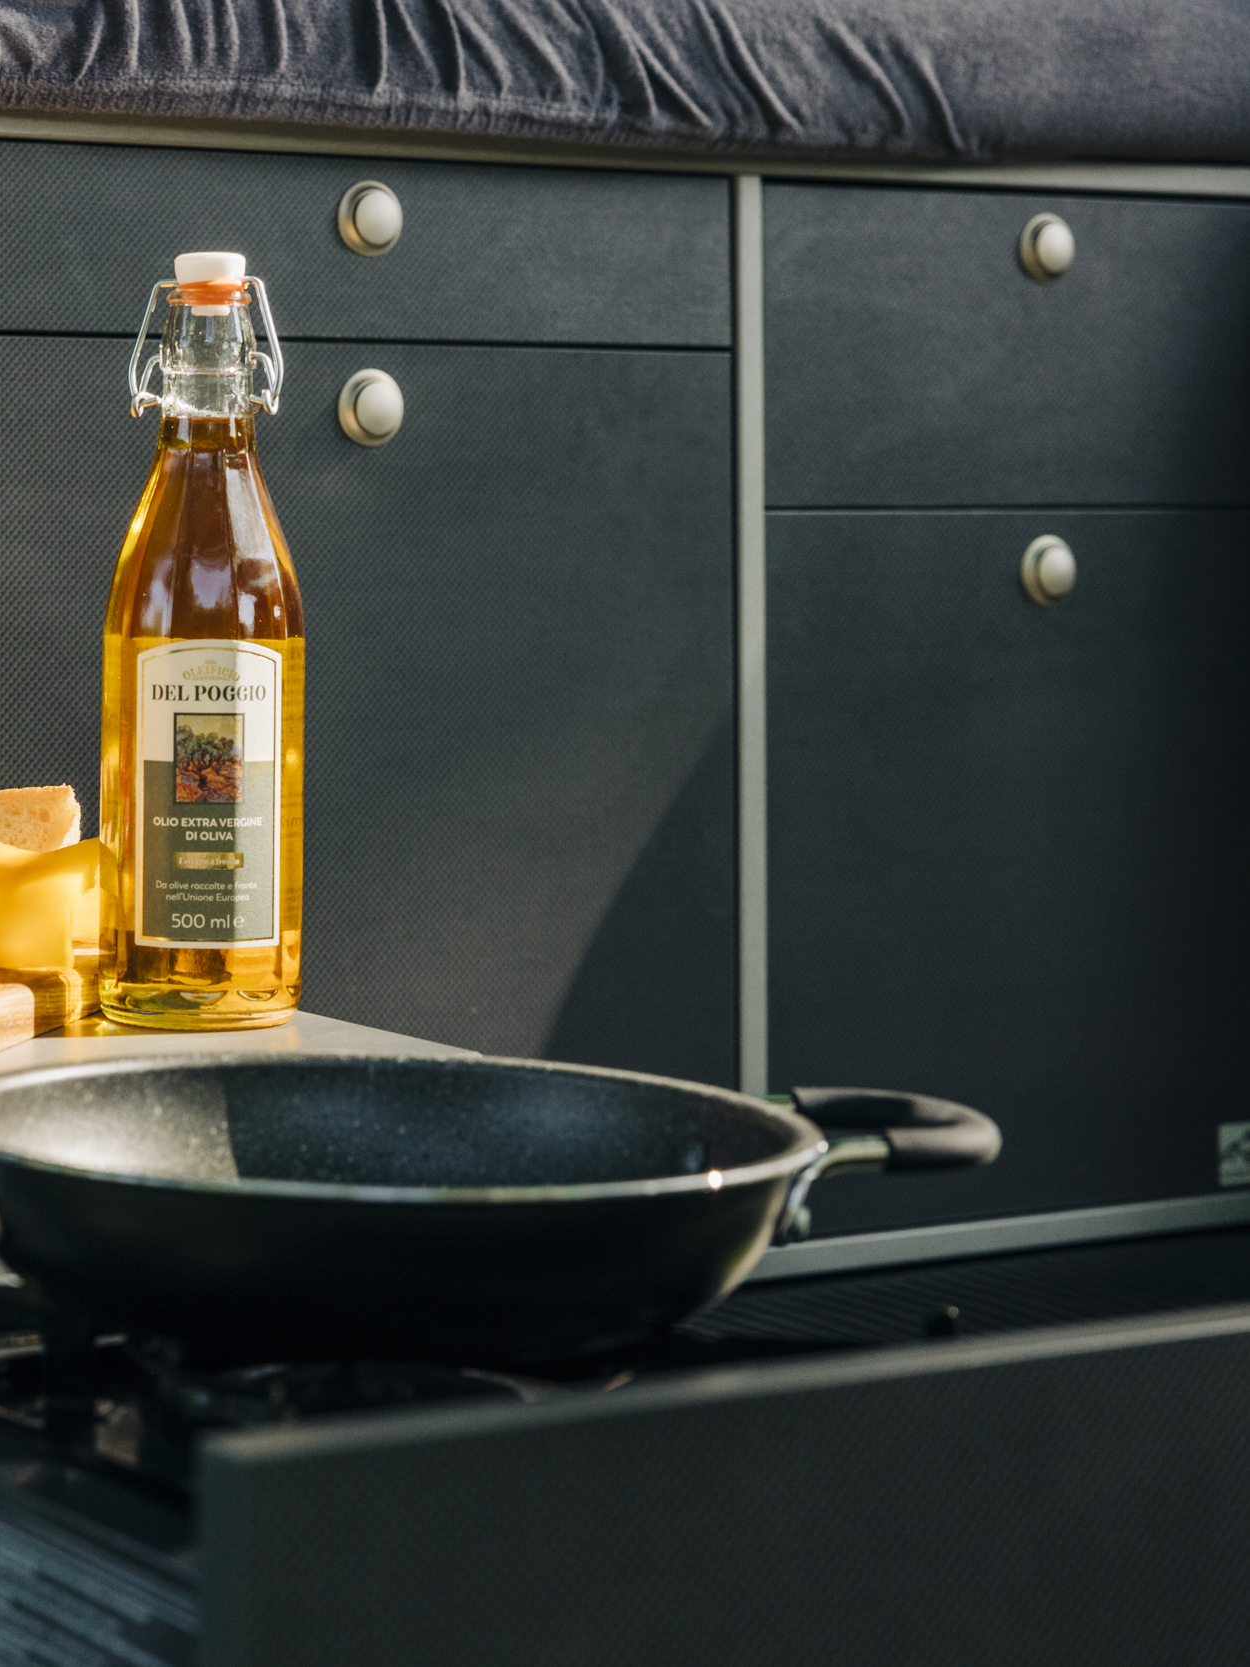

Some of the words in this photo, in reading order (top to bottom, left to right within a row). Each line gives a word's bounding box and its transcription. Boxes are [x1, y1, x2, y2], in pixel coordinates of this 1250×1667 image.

[183, 665, 240, 681] OLEIFICIO
[152, 684, 189, 701] DEL
[194, 684, 266, 702] POGGIO
[153, 816, 178, 827] OLIO
[181, 817, 217, 828] EXTRA
[219, 817, 263, 828] VERGINE
[185, 831, 197, 841] DI
[200, 831, 233, 841] OLIVA
[156, 880, 167, 889] Da
[169, 881, 189, 890] olive
[191, 881, 225, 890] raccolte
[166, 892, 214, 901] nell'Unione
[216, 893, 250, 902] Europea
[171, 913, 206, 929] 500
[210, 914, 230, 929] ml
